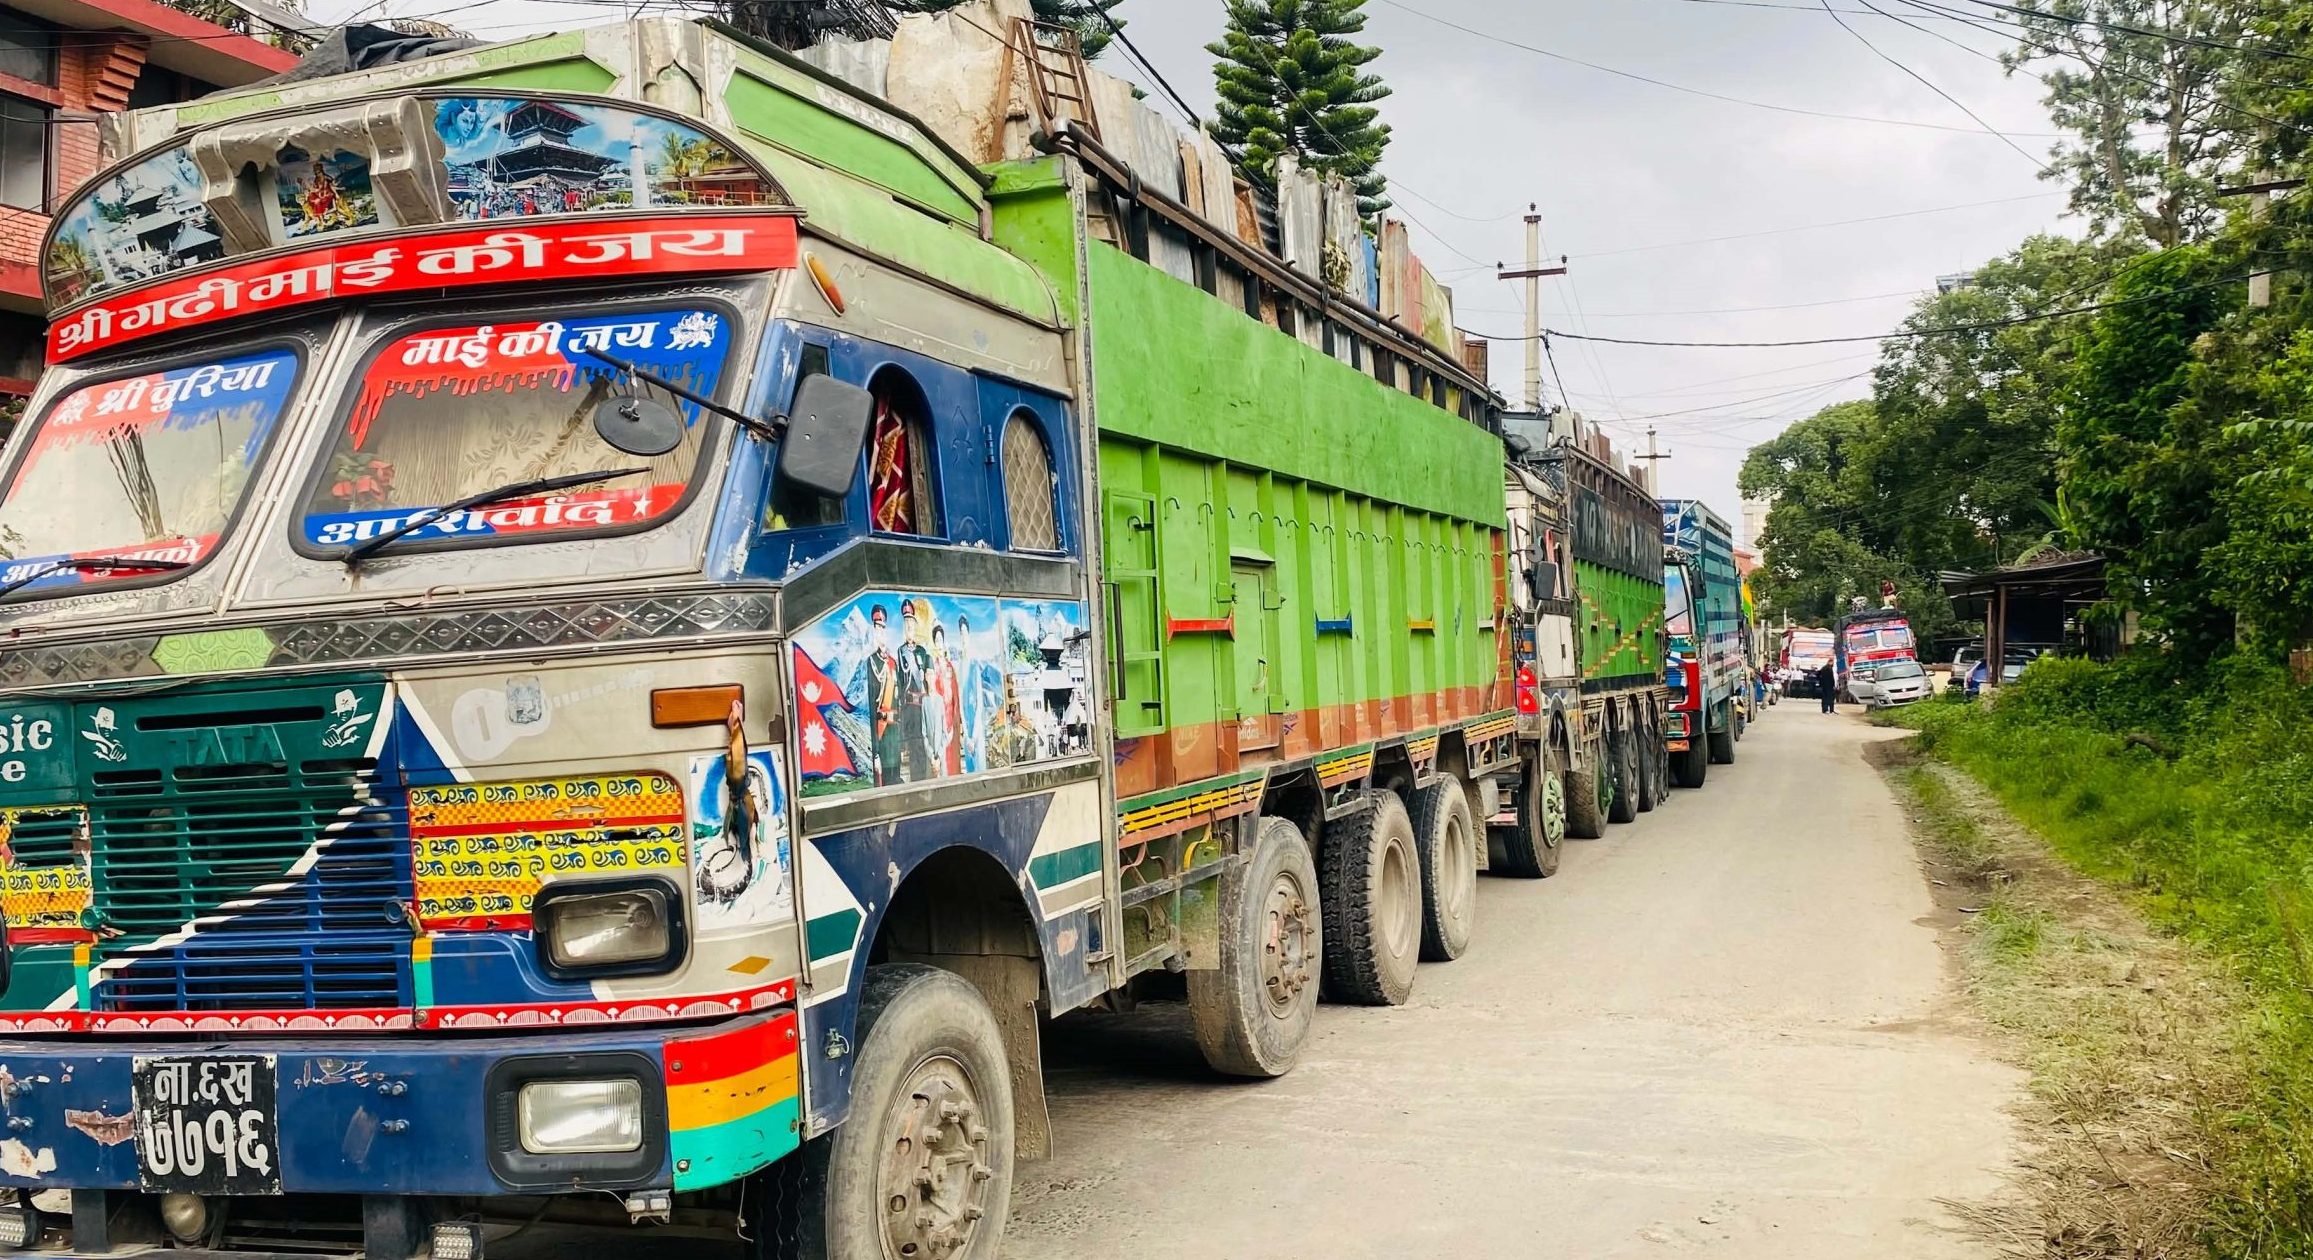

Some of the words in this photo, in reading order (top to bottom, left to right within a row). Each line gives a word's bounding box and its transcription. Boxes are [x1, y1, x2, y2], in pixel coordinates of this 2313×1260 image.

[58, 308, 117, 353] श्री
[416, 232, 553, 275] की
[561, 229, 755, 264] जय
[402, 326, 496, 369] माई
[499, 321, 566, 358] की
[569, 321, 661, 353] जय
[91, 378, 150, 418] श्री
[142, 1109, 271, 1176] ७७१६
